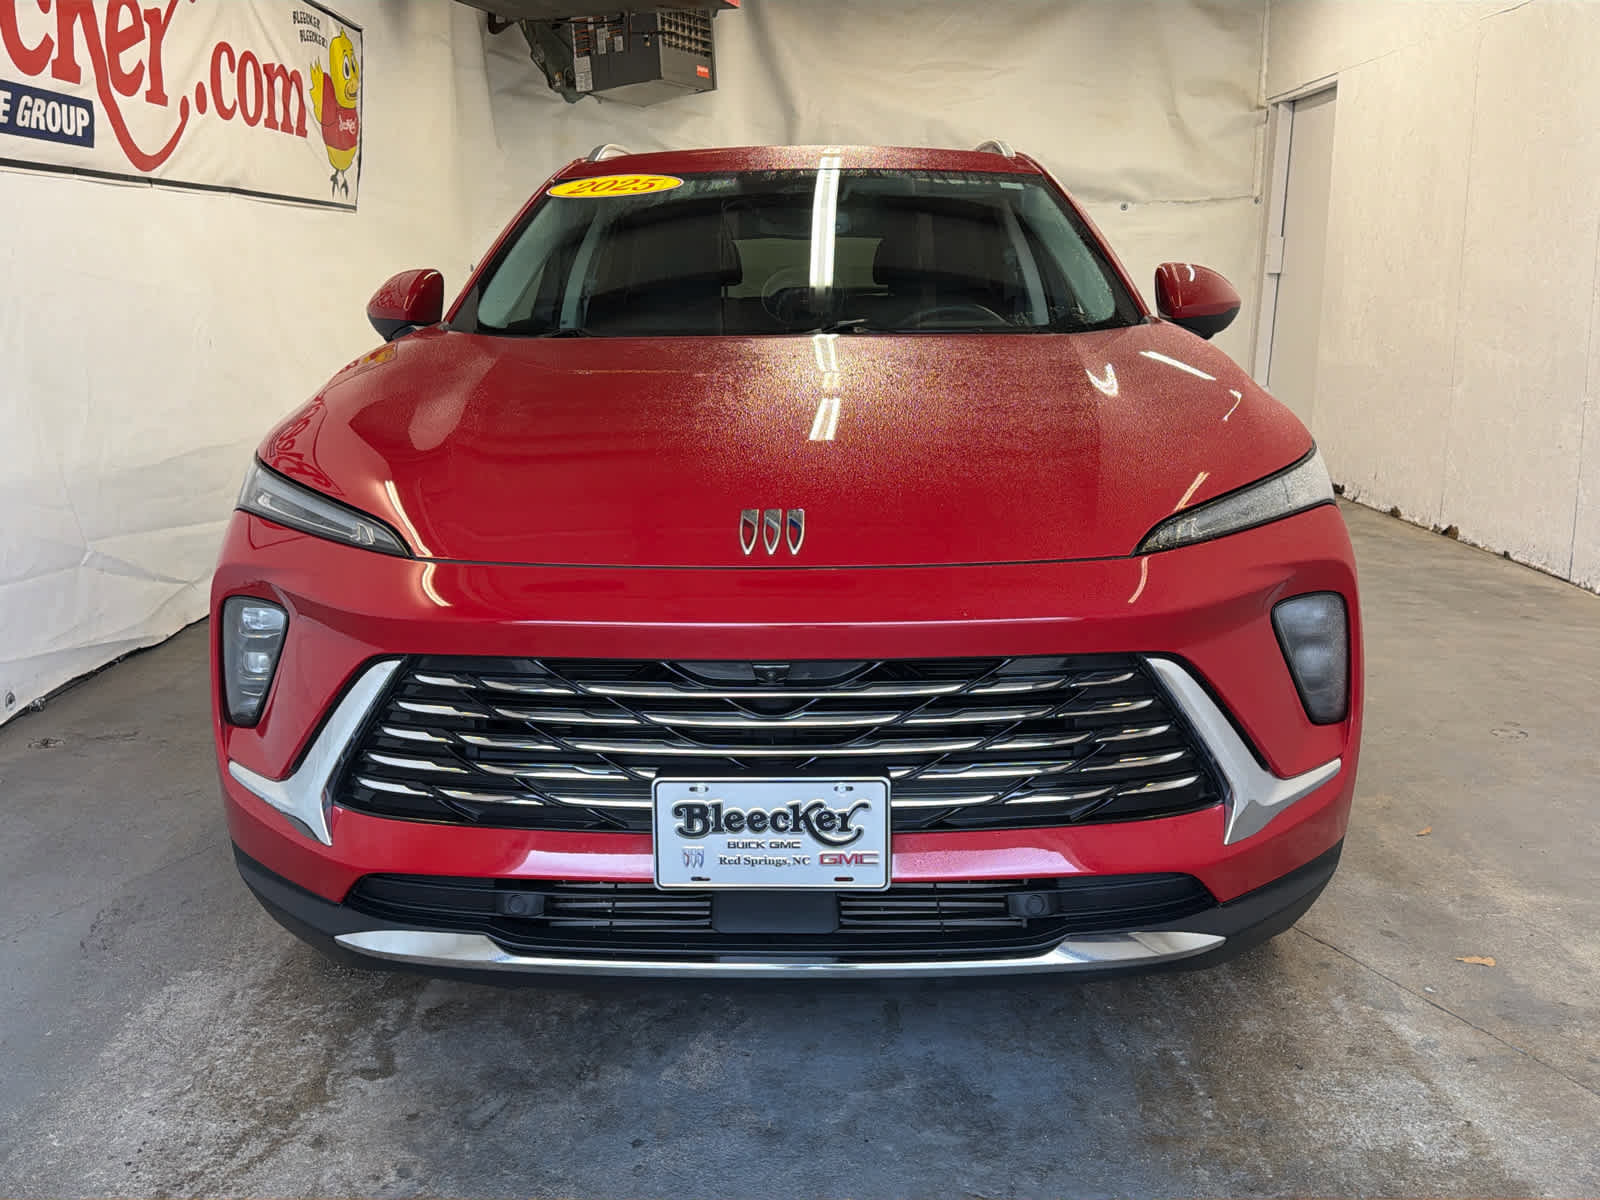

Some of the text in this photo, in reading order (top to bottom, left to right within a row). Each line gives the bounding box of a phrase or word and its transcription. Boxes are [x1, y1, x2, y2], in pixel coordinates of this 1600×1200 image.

[16, 95, 90, 136] GROUP
[567, 178, 665, 194] 2025
[727, 841, 801, 849] BUICK GMC
[719, 855, 811, 868] Red Springs, NC
[819, 853, 880, 865] GMC
